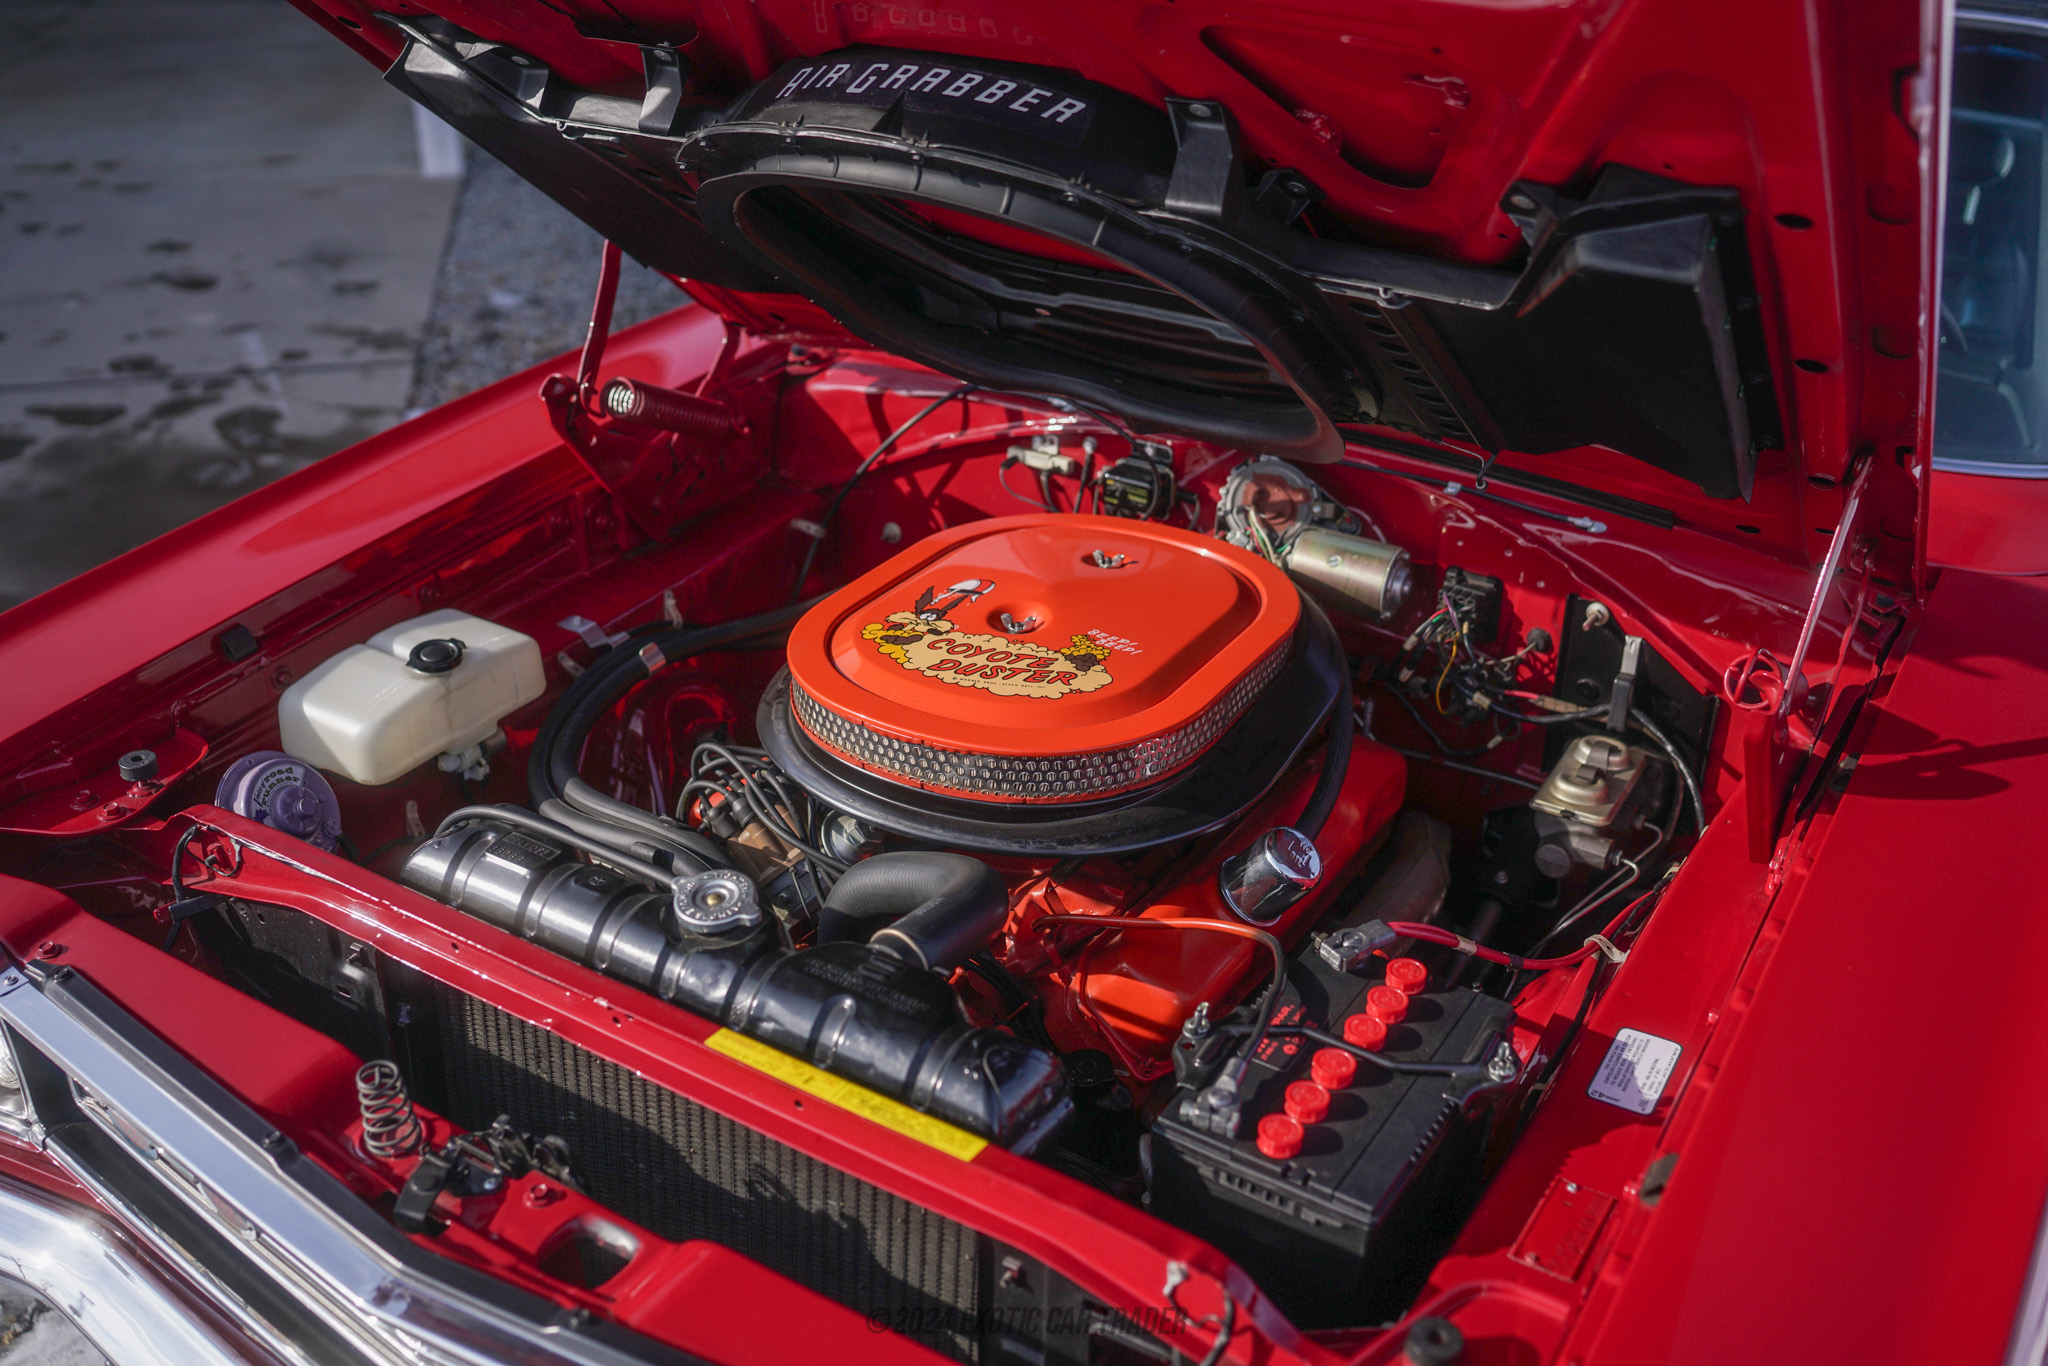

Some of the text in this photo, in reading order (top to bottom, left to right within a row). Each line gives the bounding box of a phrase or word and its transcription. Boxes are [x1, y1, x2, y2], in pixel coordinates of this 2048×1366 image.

[775, 63, 1087, 123] AIR GRABBER
[1087, 628, 1139, 646] BEEP!
[1095, 638, 1143, 655] BEEP!
[927, 638, 1059, 669] COYOTE
[926, 659, 1078, 686] DUSTER
